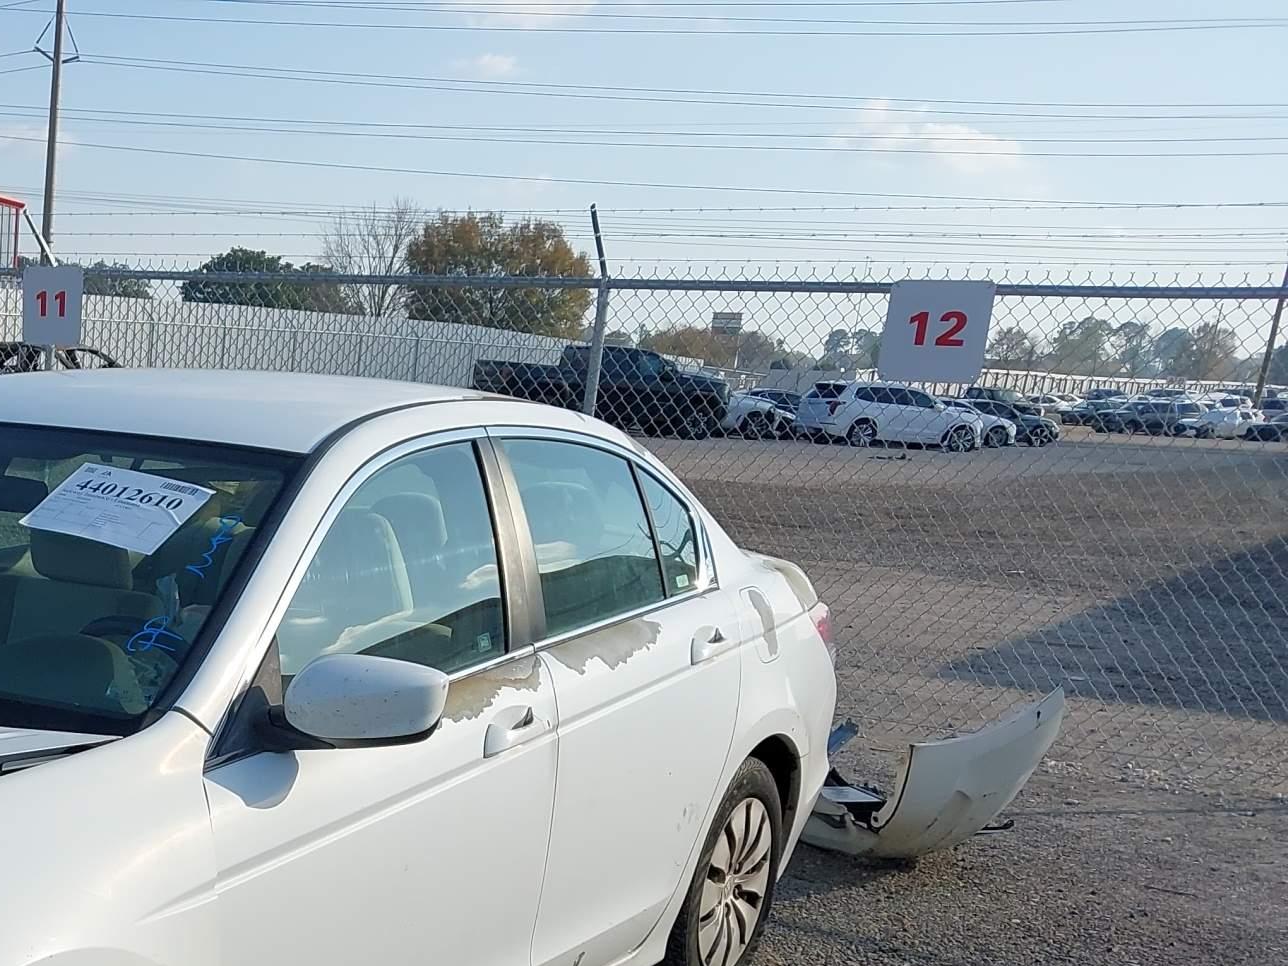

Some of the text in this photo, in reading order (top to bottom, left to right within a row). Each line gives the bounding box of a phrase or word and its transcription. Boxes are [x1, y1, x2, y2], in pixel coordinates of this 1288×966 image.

[36, 290, 66, 318] 11
[909, 311, 968, 347] 12
[76, 479, 184, 511] 44012610
